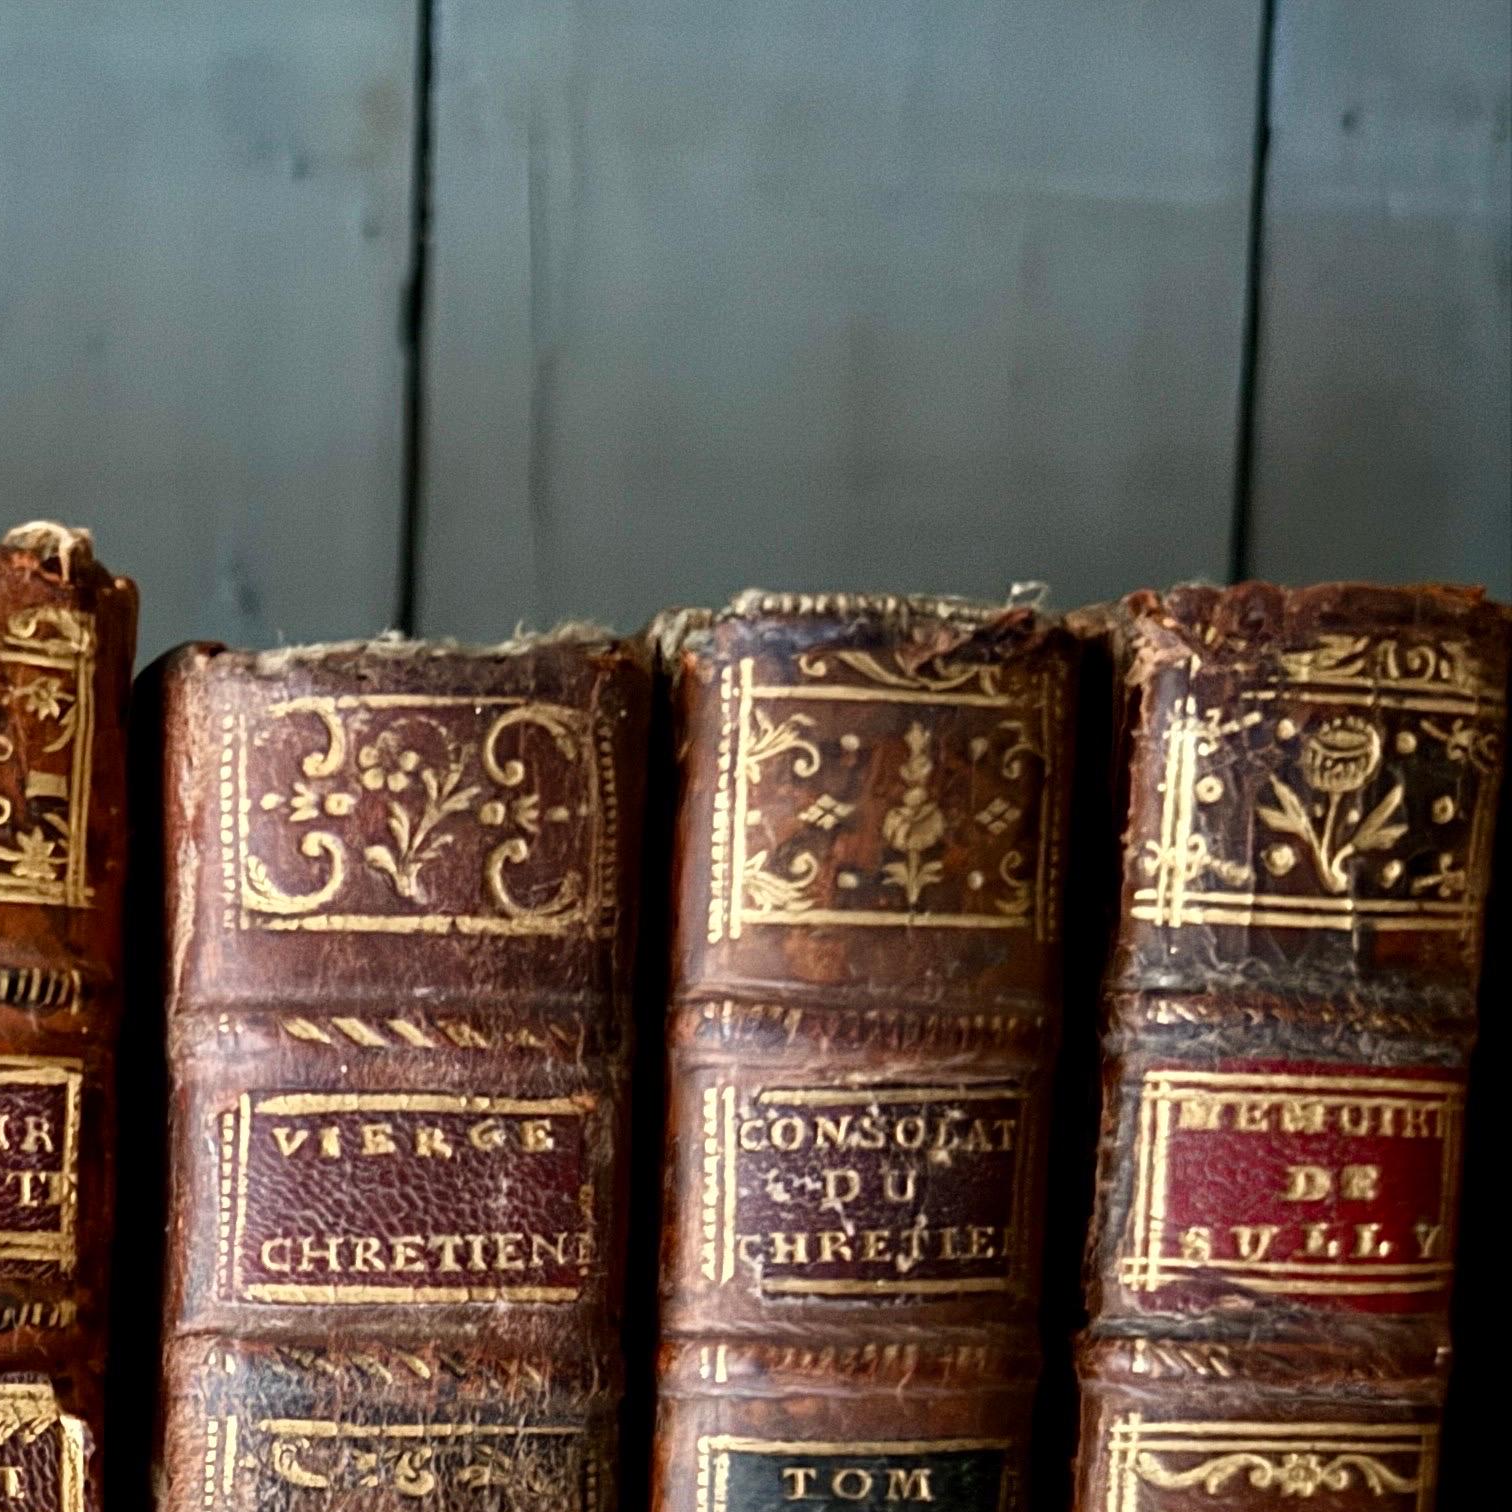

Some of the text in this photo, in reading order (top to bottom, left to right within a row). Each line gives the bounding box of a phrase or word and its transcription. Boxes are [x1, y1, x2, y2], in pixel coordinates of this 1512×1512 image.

[271, 1119, 555, 1160] VIERGE
[739, 1115, 1017, 1152] CONSOLAT
[821, 1167, 918, 1203] DU
[1282, 1163, 1379, 1201] DE
[782, 1467, 936, 1502] TOM
